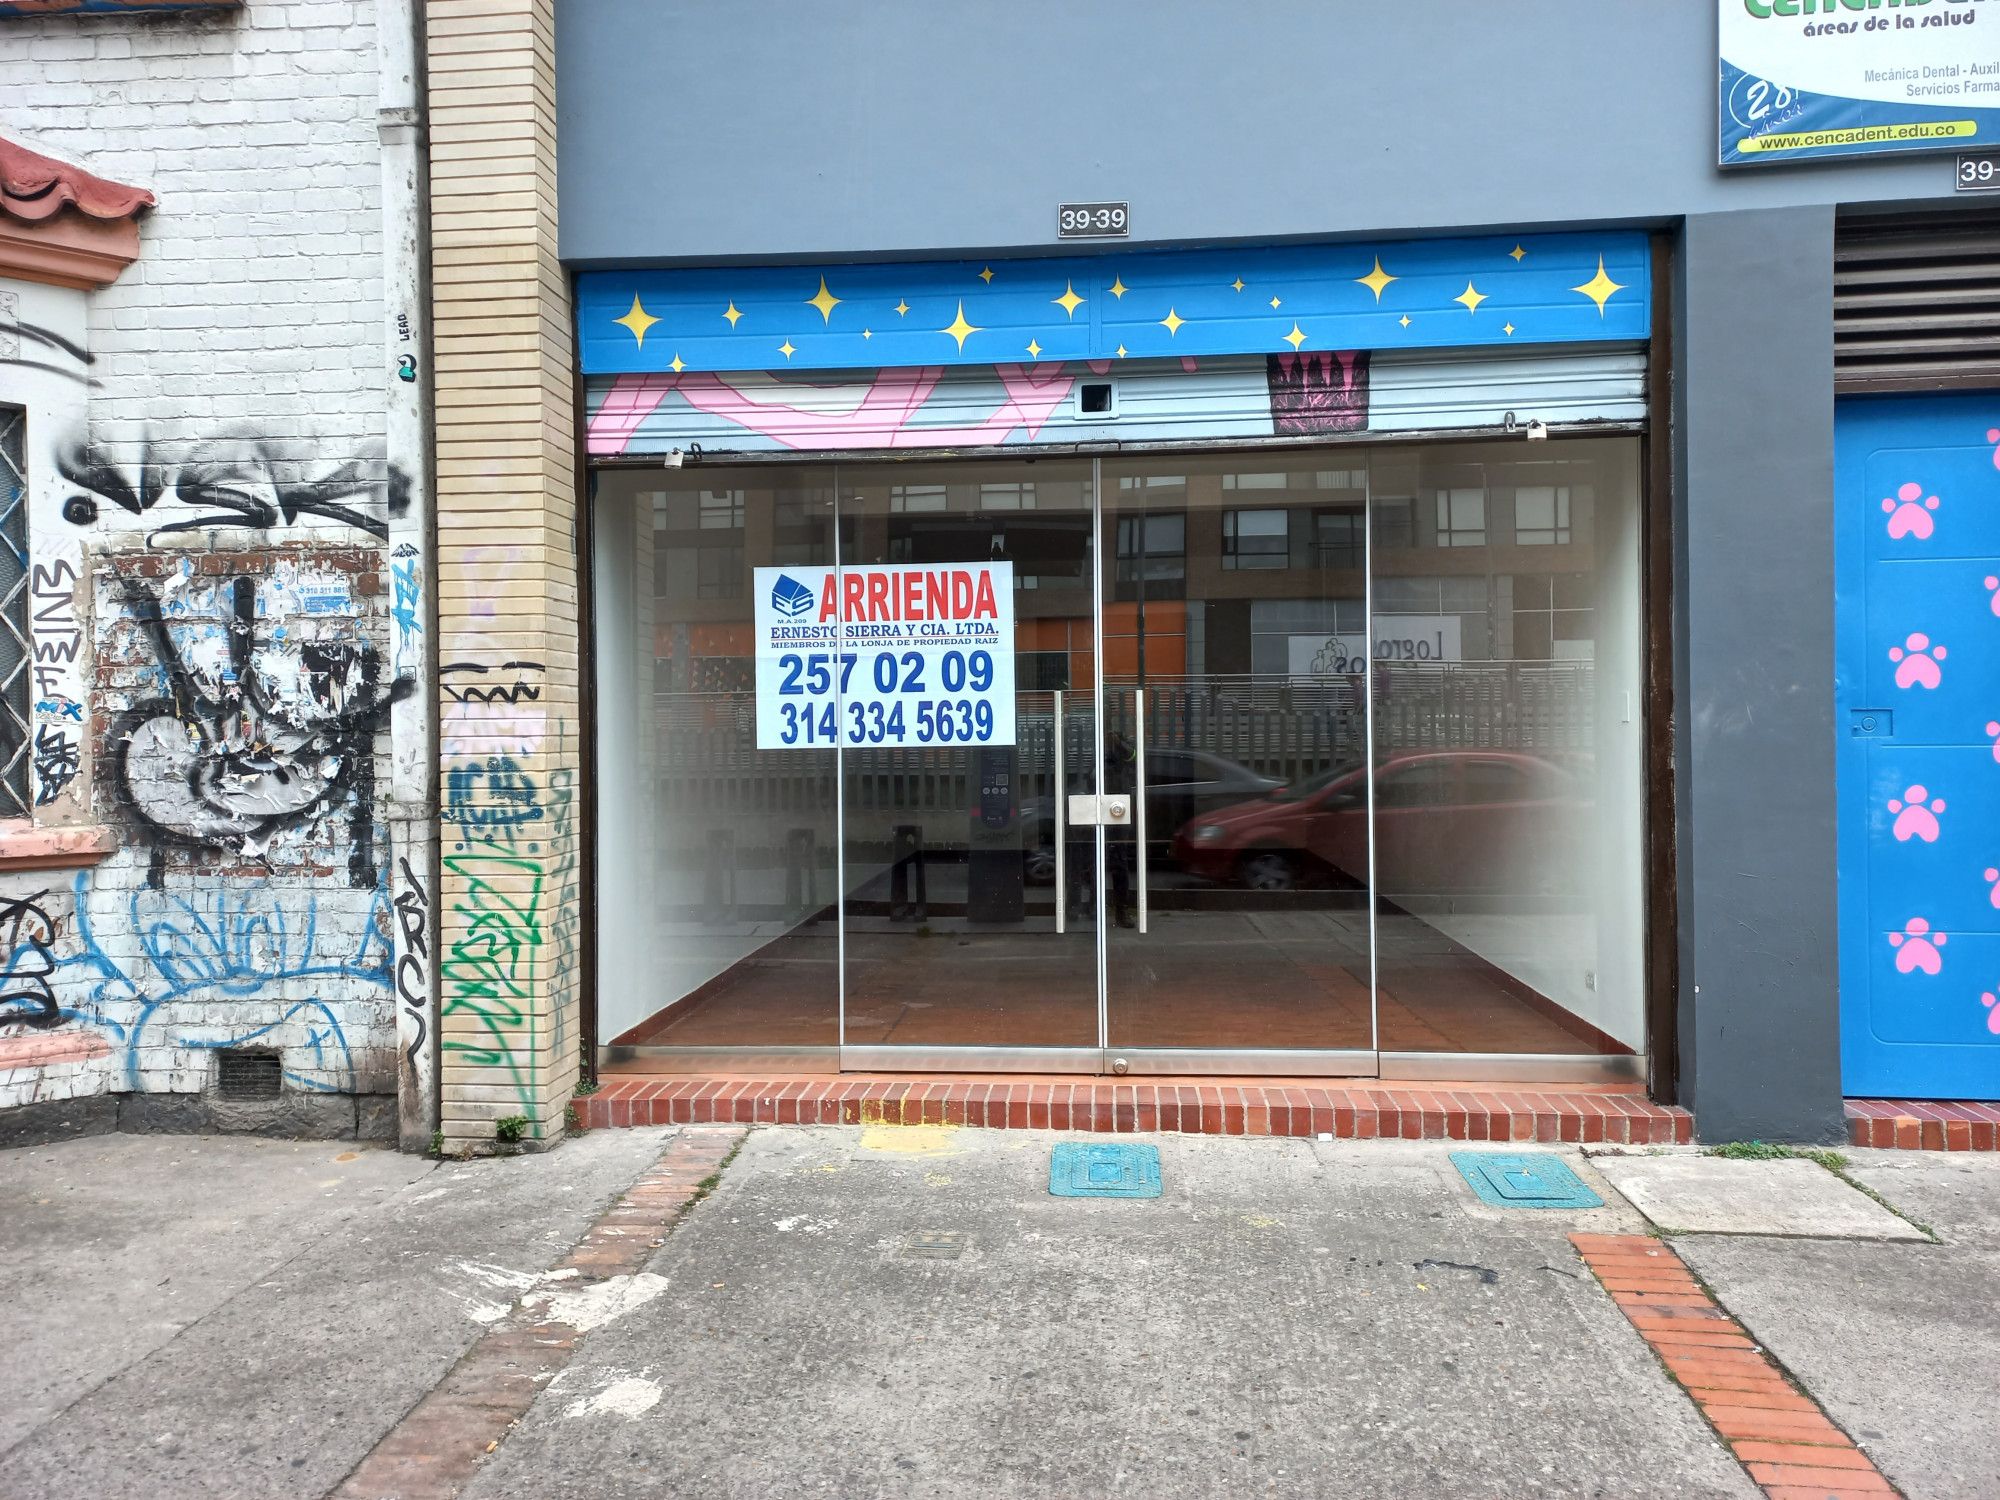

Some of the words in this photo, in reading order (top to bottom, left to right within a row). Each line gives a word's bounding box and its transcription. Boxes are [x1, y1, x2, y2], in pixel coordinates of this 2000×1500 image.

[1803, 21, 1858, 37] áreas
[1864, 15, 1889, 31] de
[1896, 13, 1915, 29] la
[1921, 9, 1975, 28] salud
[1864, 67, 1919, 83] Mecánica
[1922, 63, 1960, 79] Dental
[1906, 81, 1960, 97] Servicios
[1964, 79, 2000, 93] Farma
[1759, 124, 1956, 150] www.cencadent.edu.co
[1061, 208, 1126, 230] 39-39
[818, 569, 999, 624] ARRIENDA
[845, 623, 901, 638] SIERRA
[906, 624, 916, 636] Y
[920, 623, 950, 636] CIA.
[955, 622, 999, 635] LTDA.
[771, 641, 826, 649] MIEMBROS
[861, 638, 894, 647] LONJA
[914, 637, 972, 646] PROPIEDAD
[975, 636, 999, 645] RAIZ
[778, 653, 858, 695] 257
[873, 651, 926, 694] 02
[941, 650, 994, 693] 09
[780, 702, 838, 745] 314
[848, 701, 906, 743] 334
[916, 699, 994, 743] 5639
